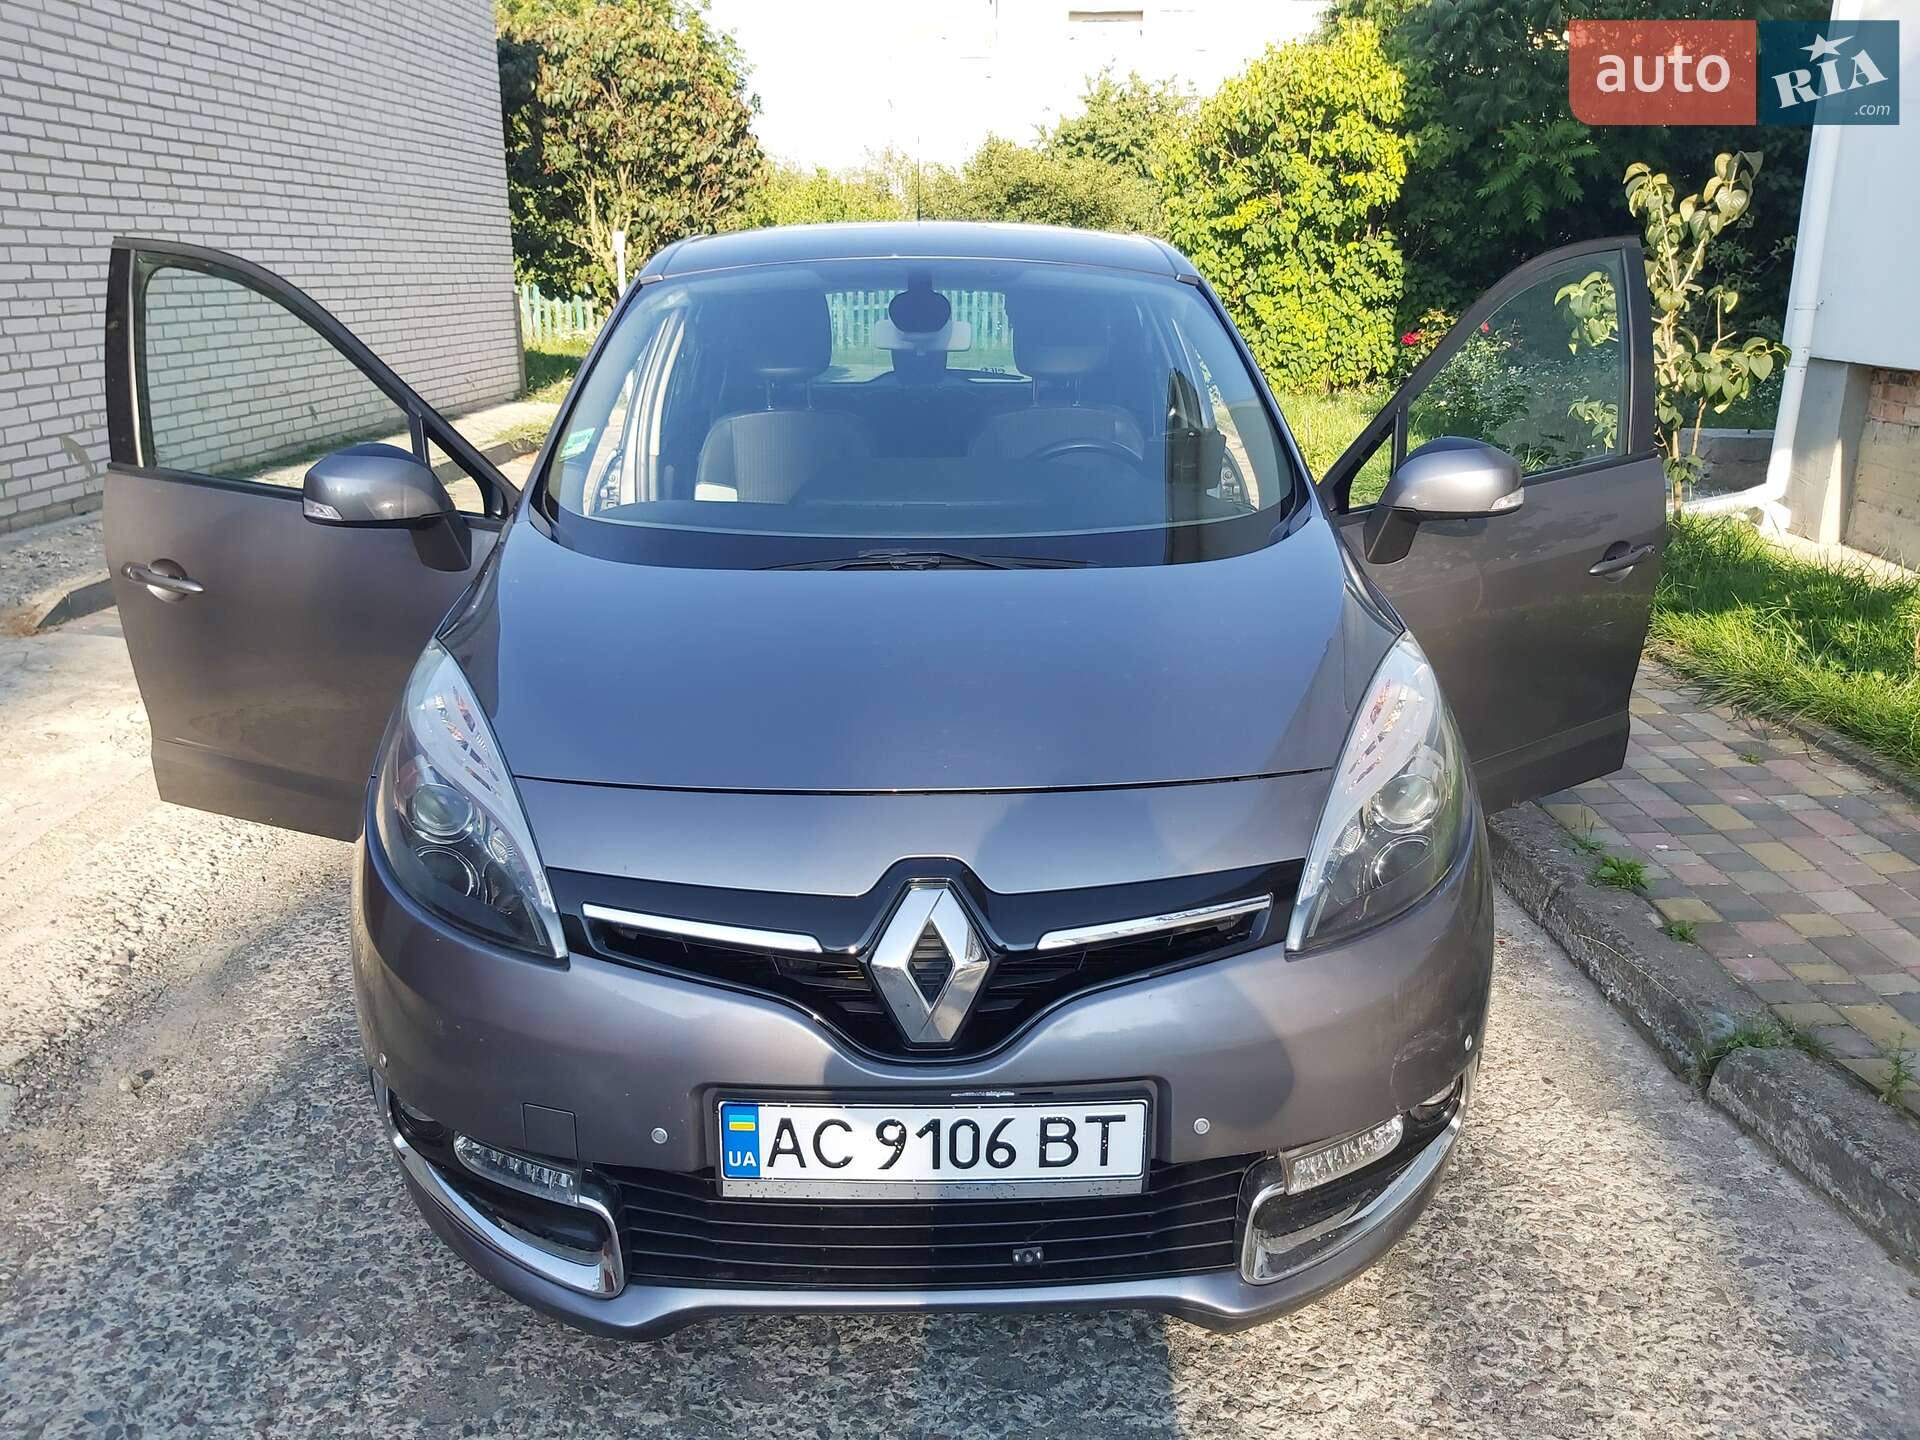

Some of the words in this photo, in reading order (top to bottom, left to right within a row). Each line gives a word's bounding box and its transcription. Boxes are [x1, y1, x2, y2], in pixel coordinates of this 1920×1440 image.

[728, 1150, 757, 1168] UA
[766, 1116, 853, 1169] AC
[875, 1118, 1018, 1170] 9106
[1038, 1114, 1127, 1167] BT
